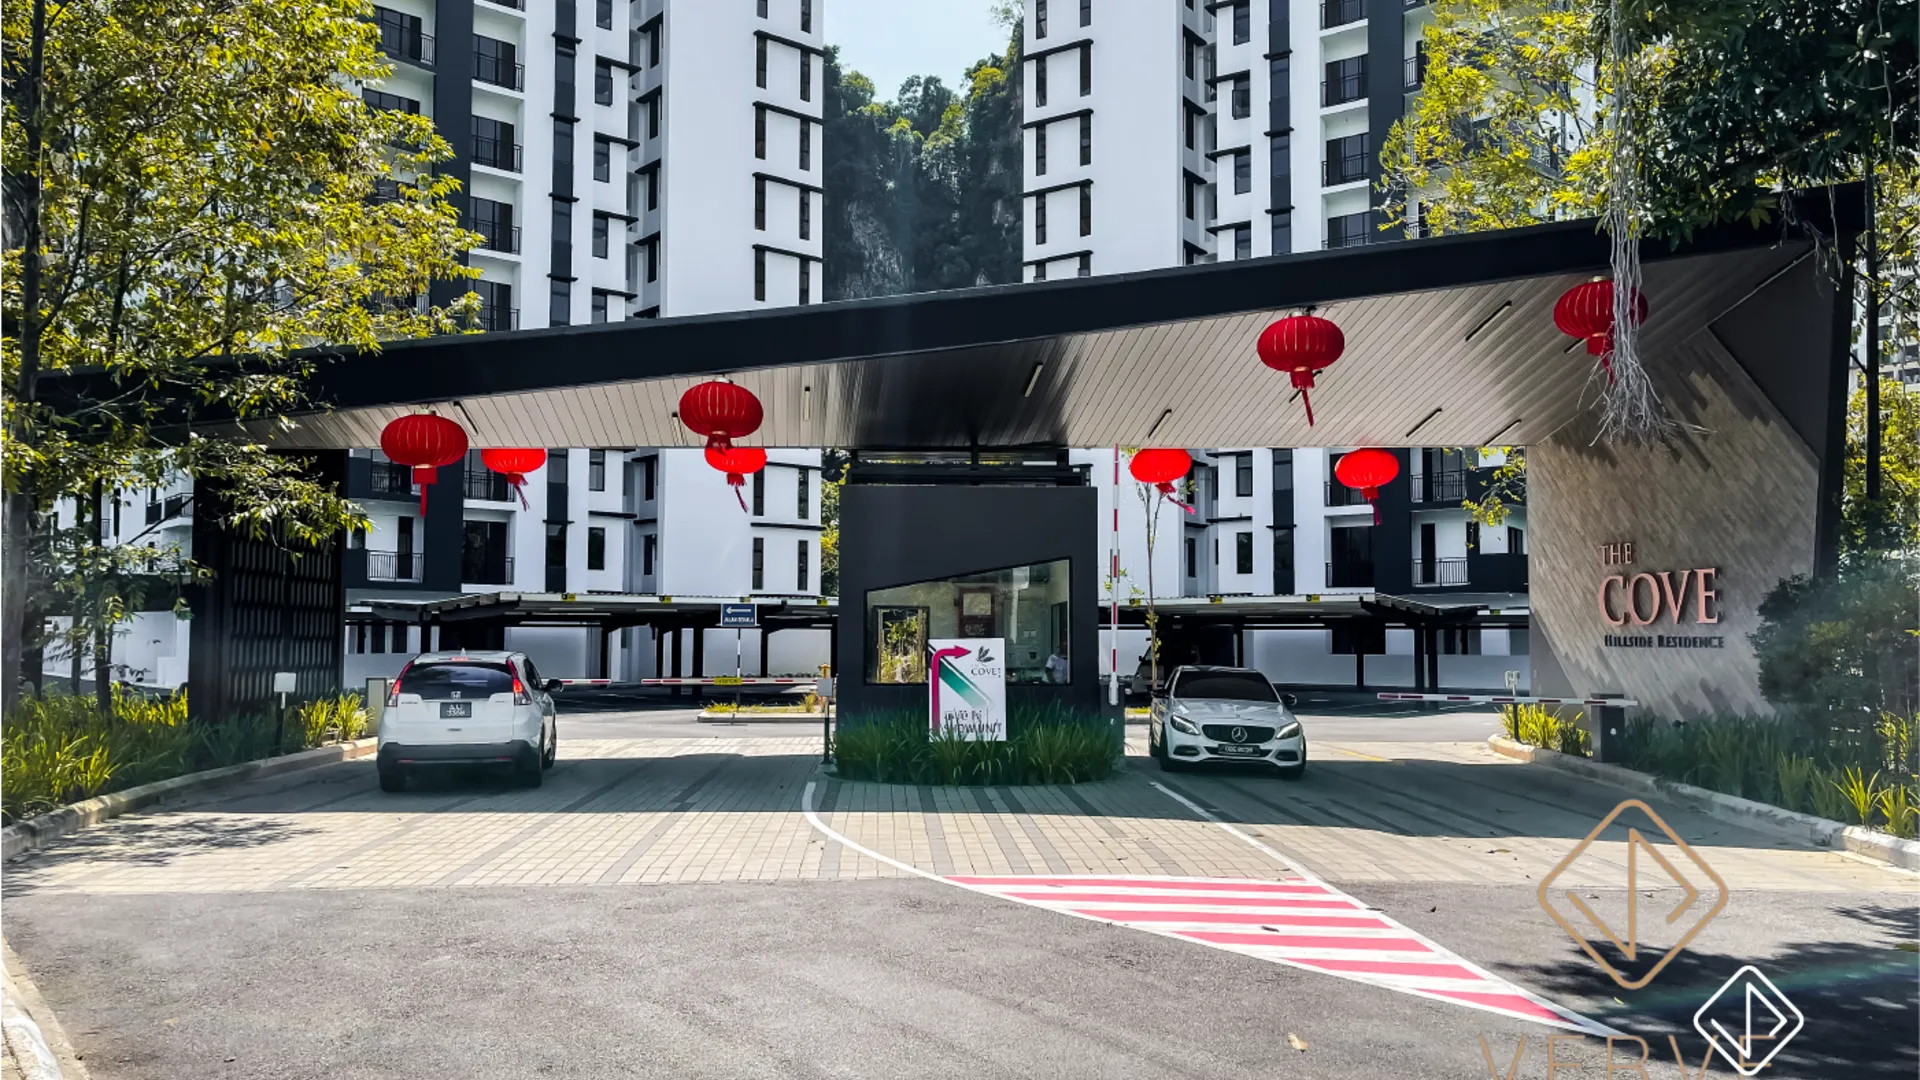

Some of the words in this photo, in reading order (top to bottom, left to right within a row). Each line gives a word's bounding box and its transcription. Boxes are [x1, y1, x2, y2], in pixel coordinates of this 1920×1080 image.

[1599, 542, 1633, 566] THE
[1598, 567, 1722, 627] COVE
[1604, 634, 1654, 648] HILLSIDE
[1657, 634, 1725, 649] RESIDENCE
